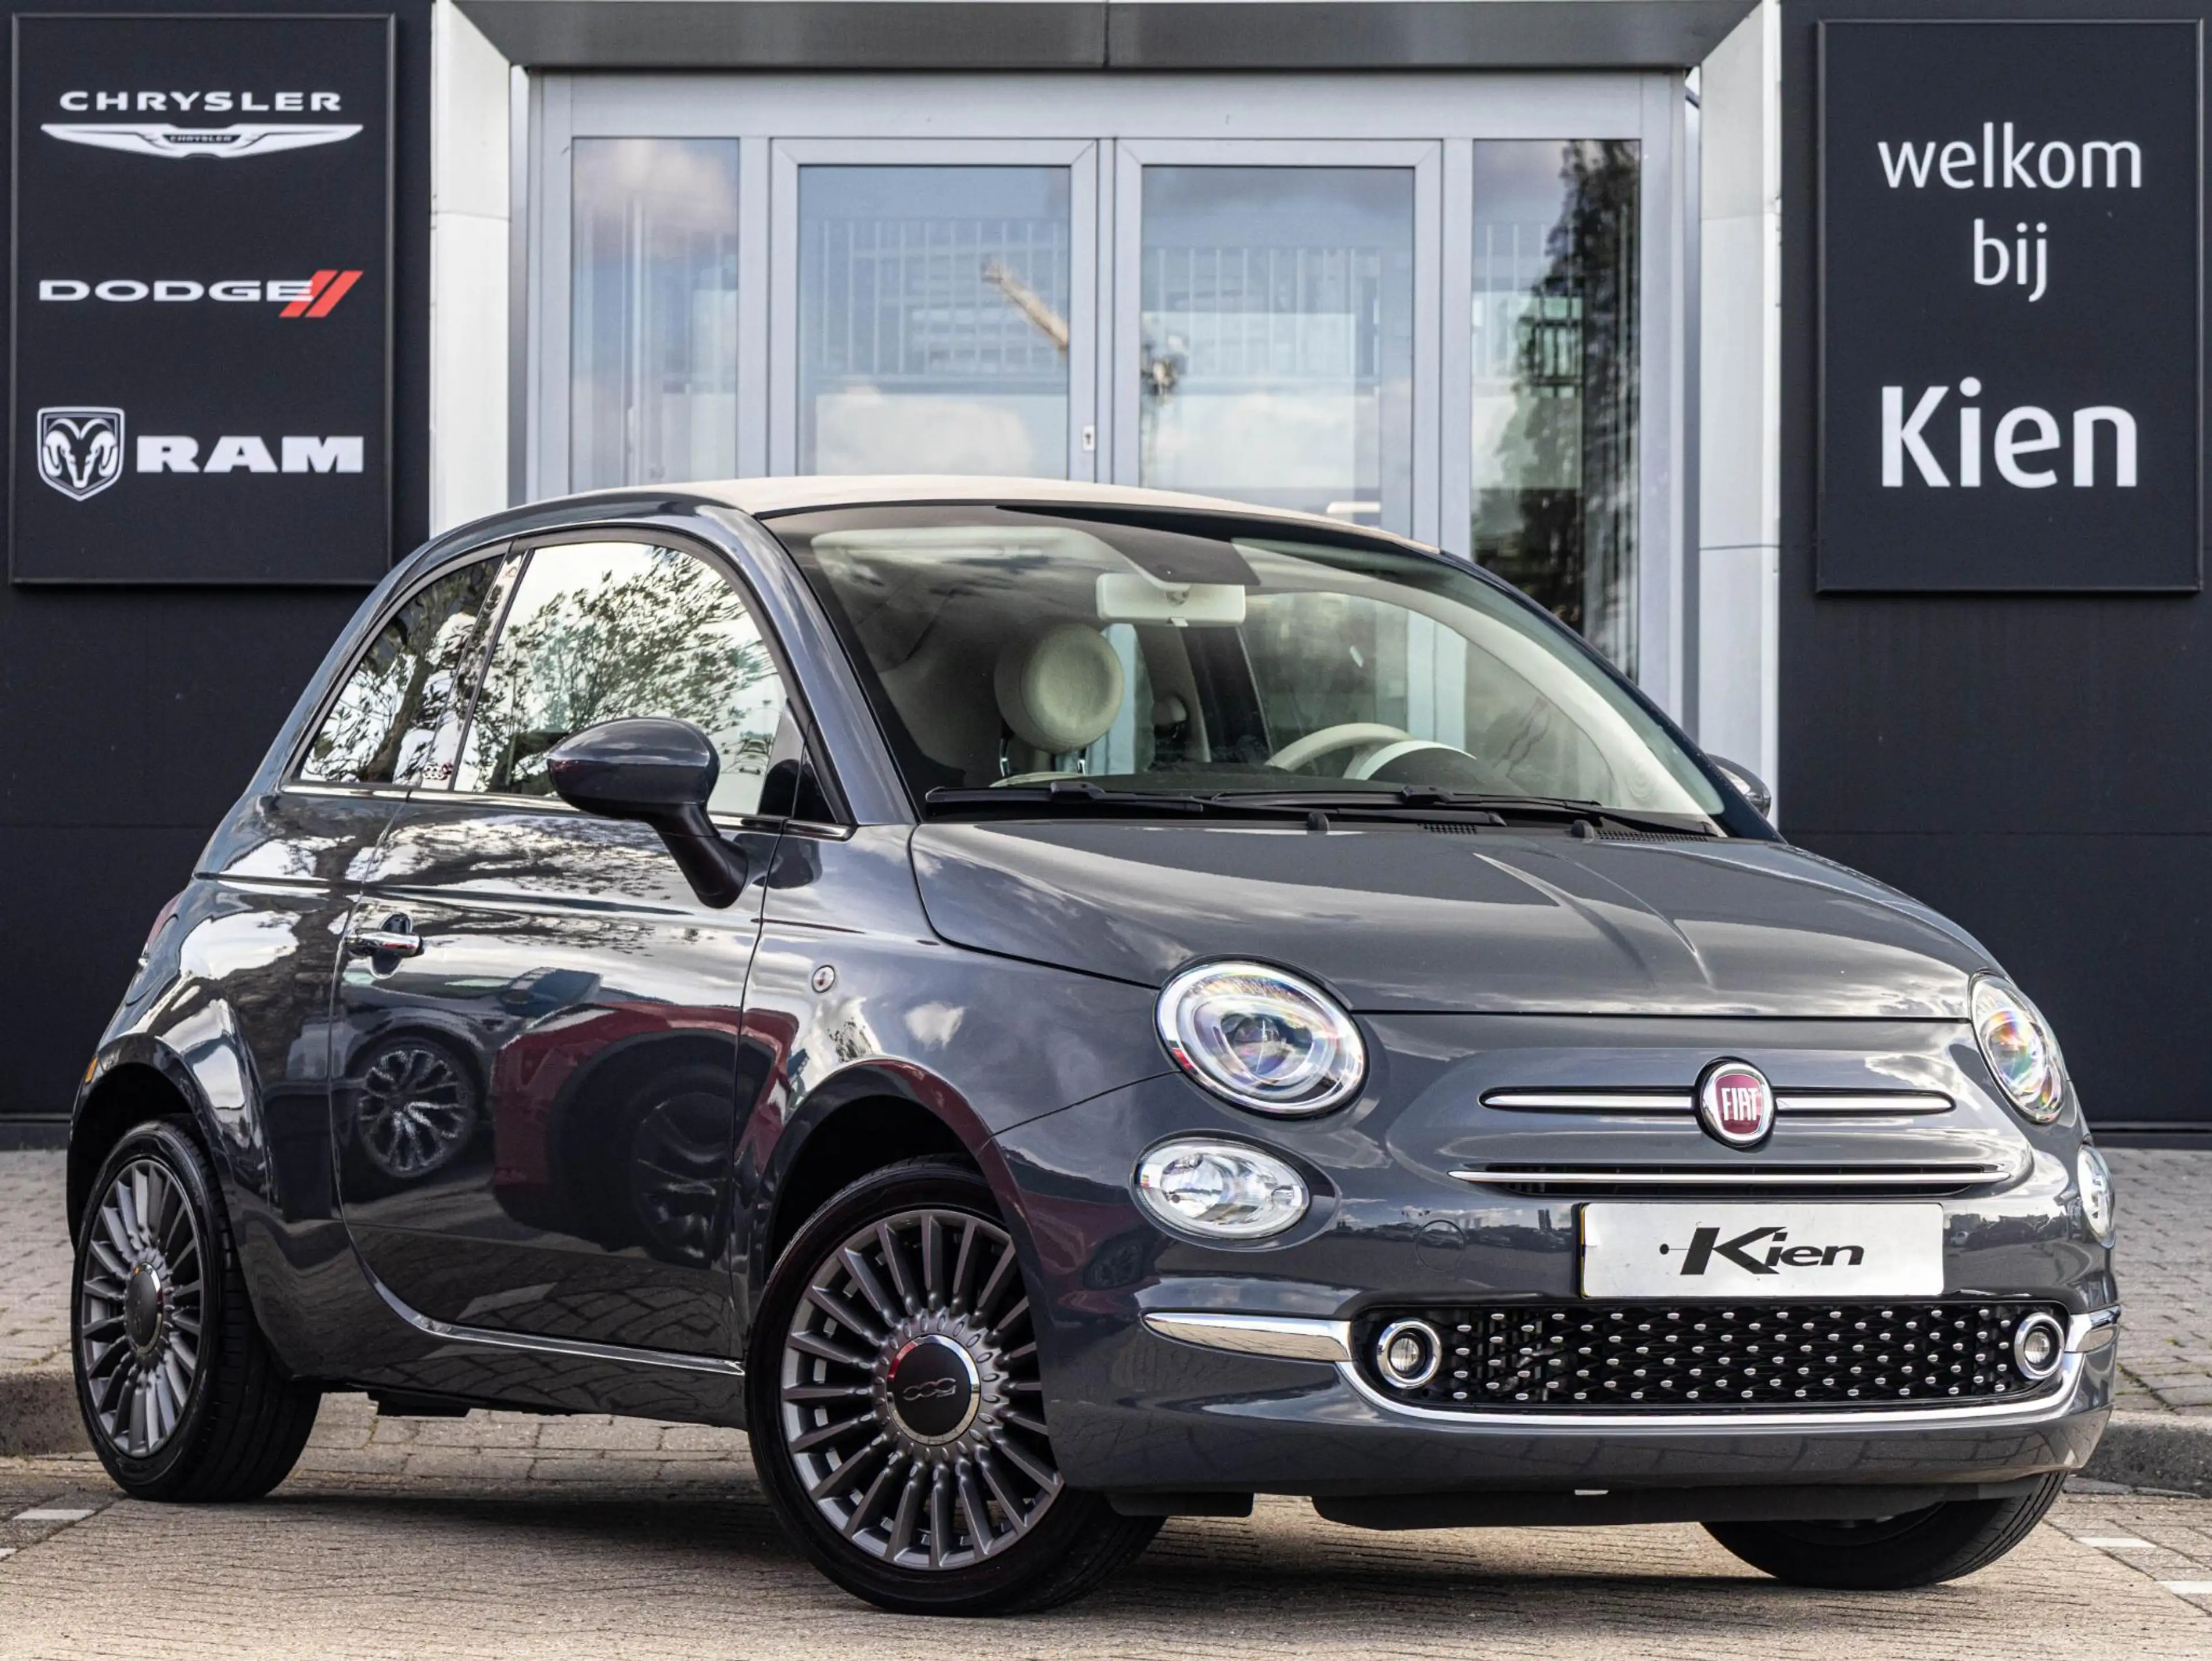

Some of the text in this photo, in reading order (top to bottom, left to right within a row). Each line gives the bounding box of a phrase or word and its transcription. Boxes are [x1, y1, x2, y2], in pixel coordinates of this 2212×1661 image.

[59, 91, 340, 111] CHRYSLER
[1878, 122, 2141, 189] welkom
[1974, 219, 2046, 302] bij
[39, 280, 314, 302] DODGE
[1882, 377, 2137, 488] Kien
[137, 436, 363, 473] RAM
[1721, 1087, 1758, 1121] FIAT
[1680, 1227, 1864, 1275] Kien
